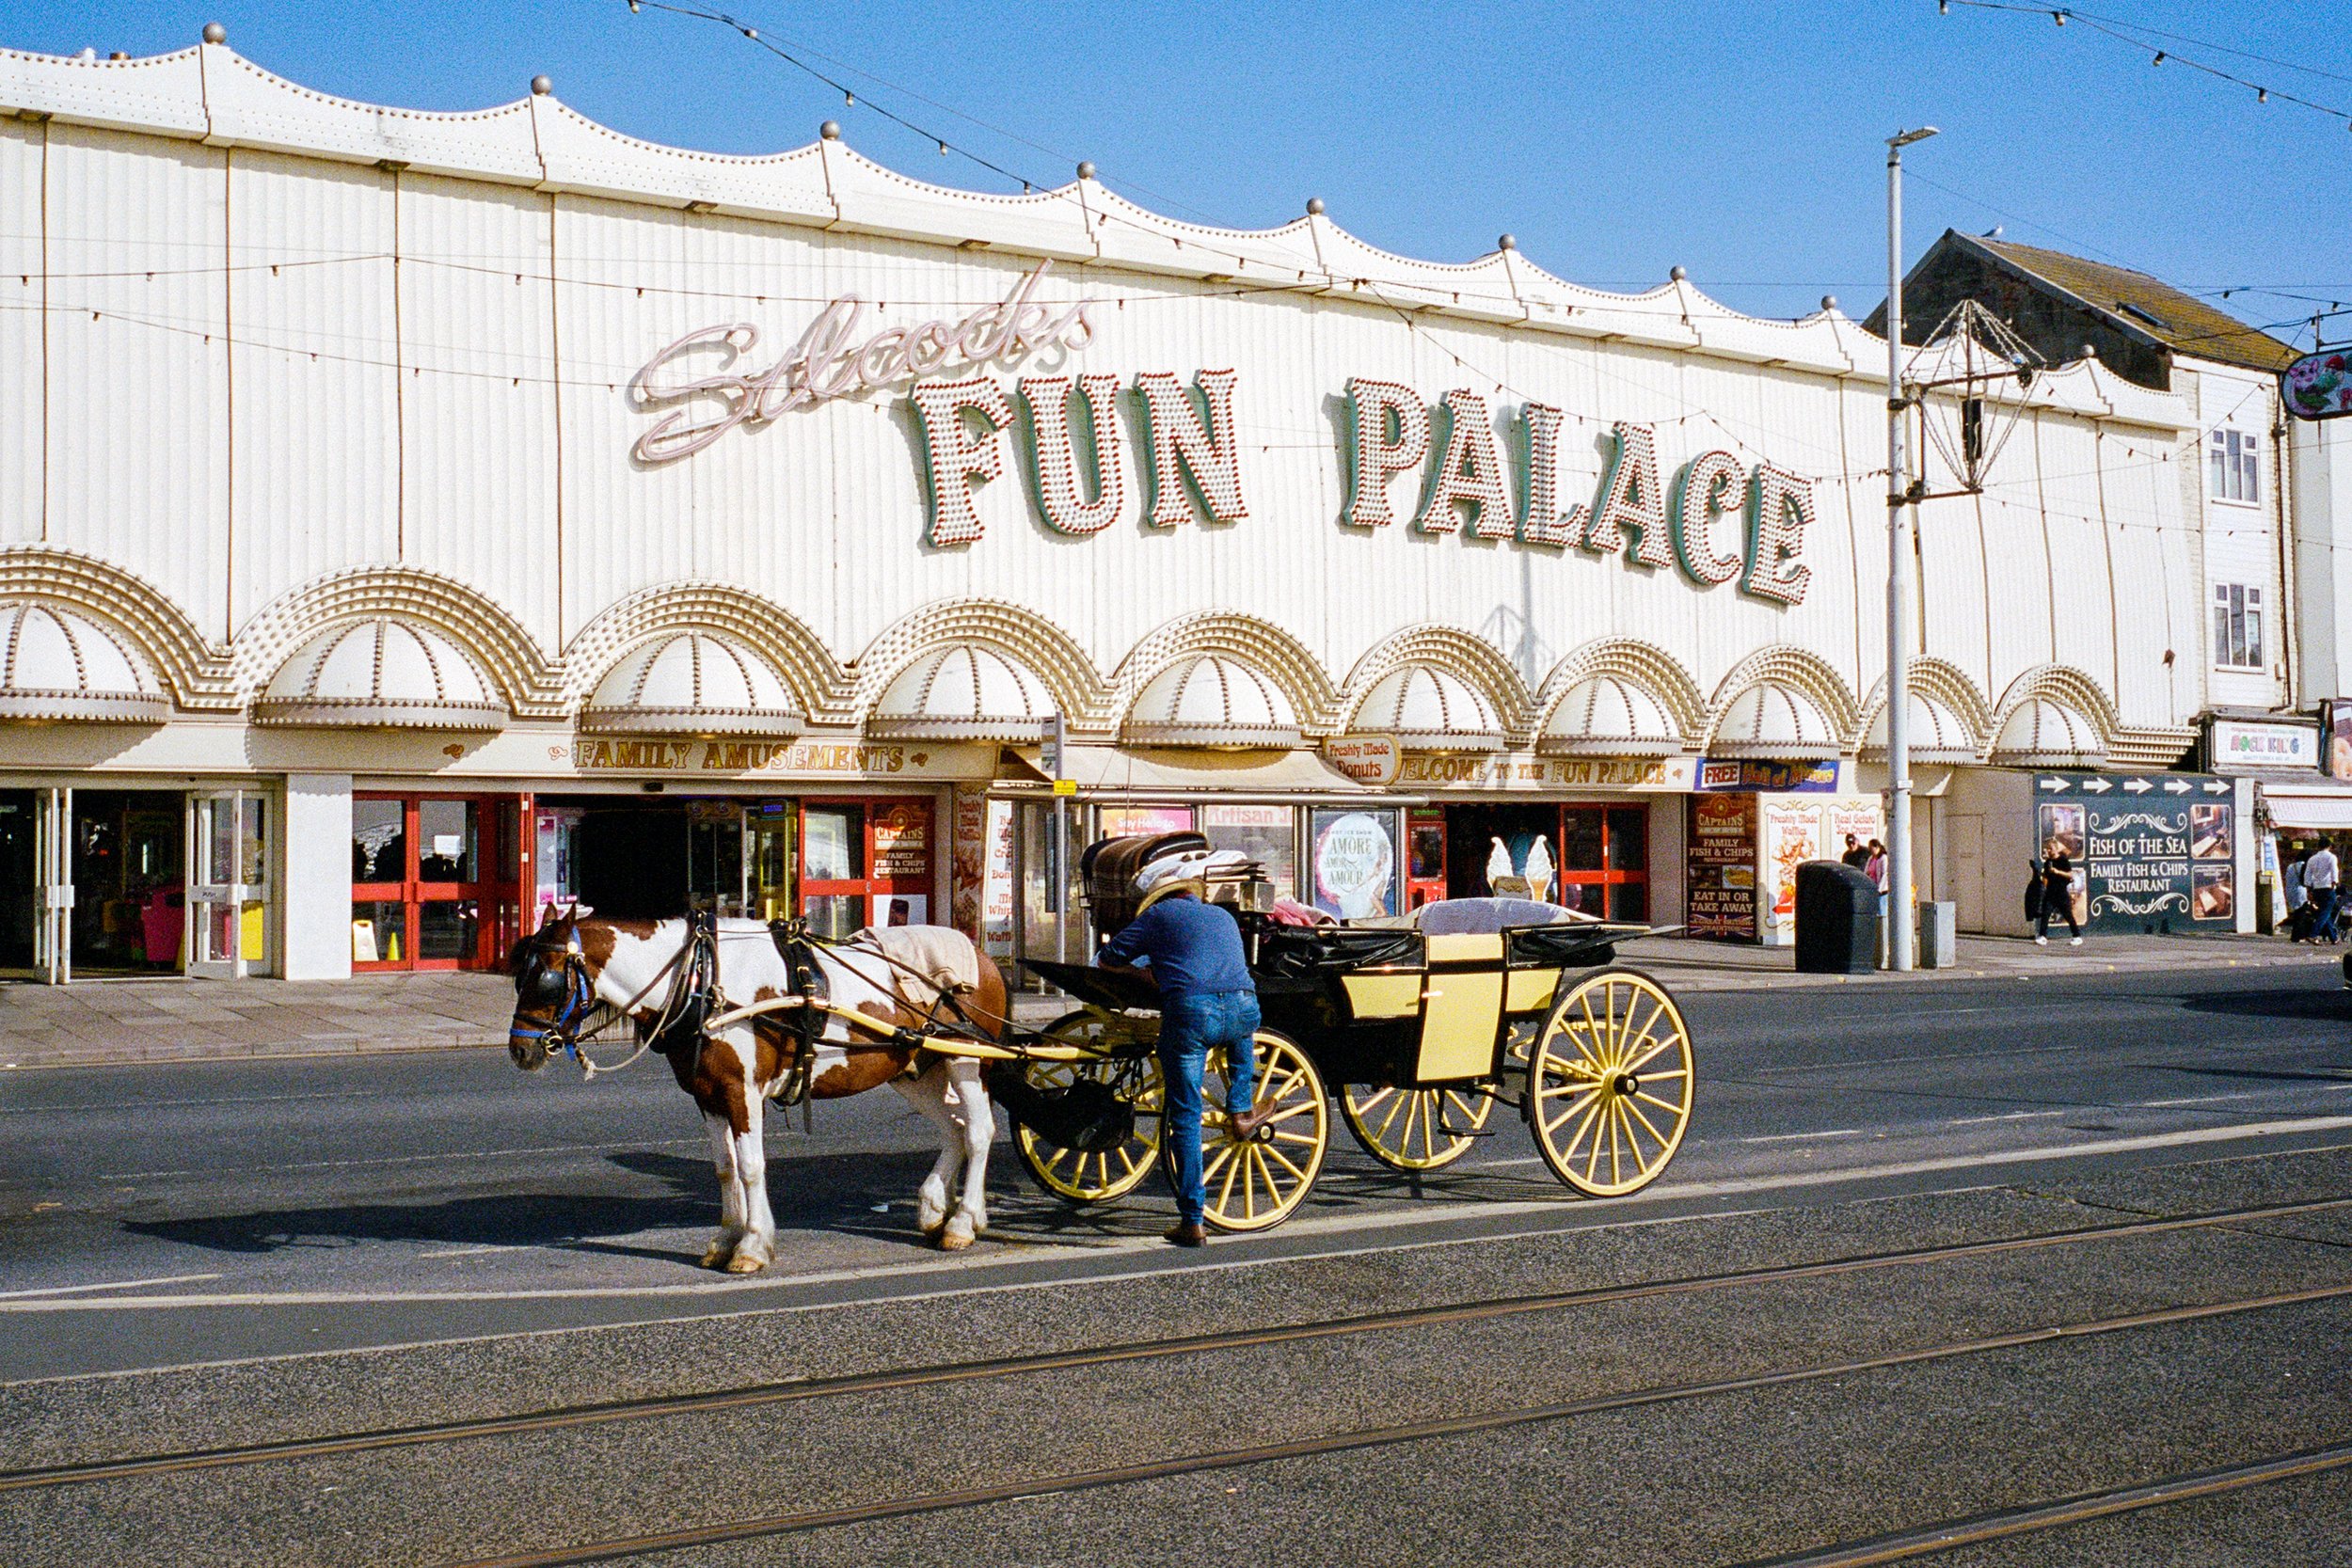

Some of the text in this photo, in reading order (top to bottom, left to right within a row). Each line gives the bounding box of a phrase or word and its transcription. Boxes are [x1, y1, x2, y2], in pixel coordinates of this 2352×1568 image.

[910, 368, 1815, 605] FUN PALACE
[575, 741, 904, 772] FAMILY AMUSEMENTS
[1329, 743, 1389, 757] Freshly Made
[1337, 761, 1382, 778] Donuts
[1495, 765, 1513, 779] TO
[1518, 764, 1544, 780] THE
[1552, 762, 1590, 783] FUN
[1597, 762, 1666, 784] PALACE
[1705, 766, 1738, 784] FREE
[1741, 763, 1771, 785] Hall
[1208, 806, 1273, 823] Artisan
[1698, 813, 1743, 826] CAPTAINS
[1330, 837, 1372, 855] AMORE
[1704, 838, 1739, 847] FAMILY
[2090, 835, 2187, 855] FISH OF THE SEA
[1690, 847, 1754, 857] FISH & CHIPS
[2090, 862, 2124, 878] FAMILY
[2126, 862, 2148, 877] FISH
[2151, 863, 2158, 876] &
[2159, 862, 2188, 876] CHIPS
[2108, 879, 2170, 893] RESTAURANT
[1694, 891, 1750, 901] EAT IN OR
[1690, 902, 1754, 912] TAKE AWAY
